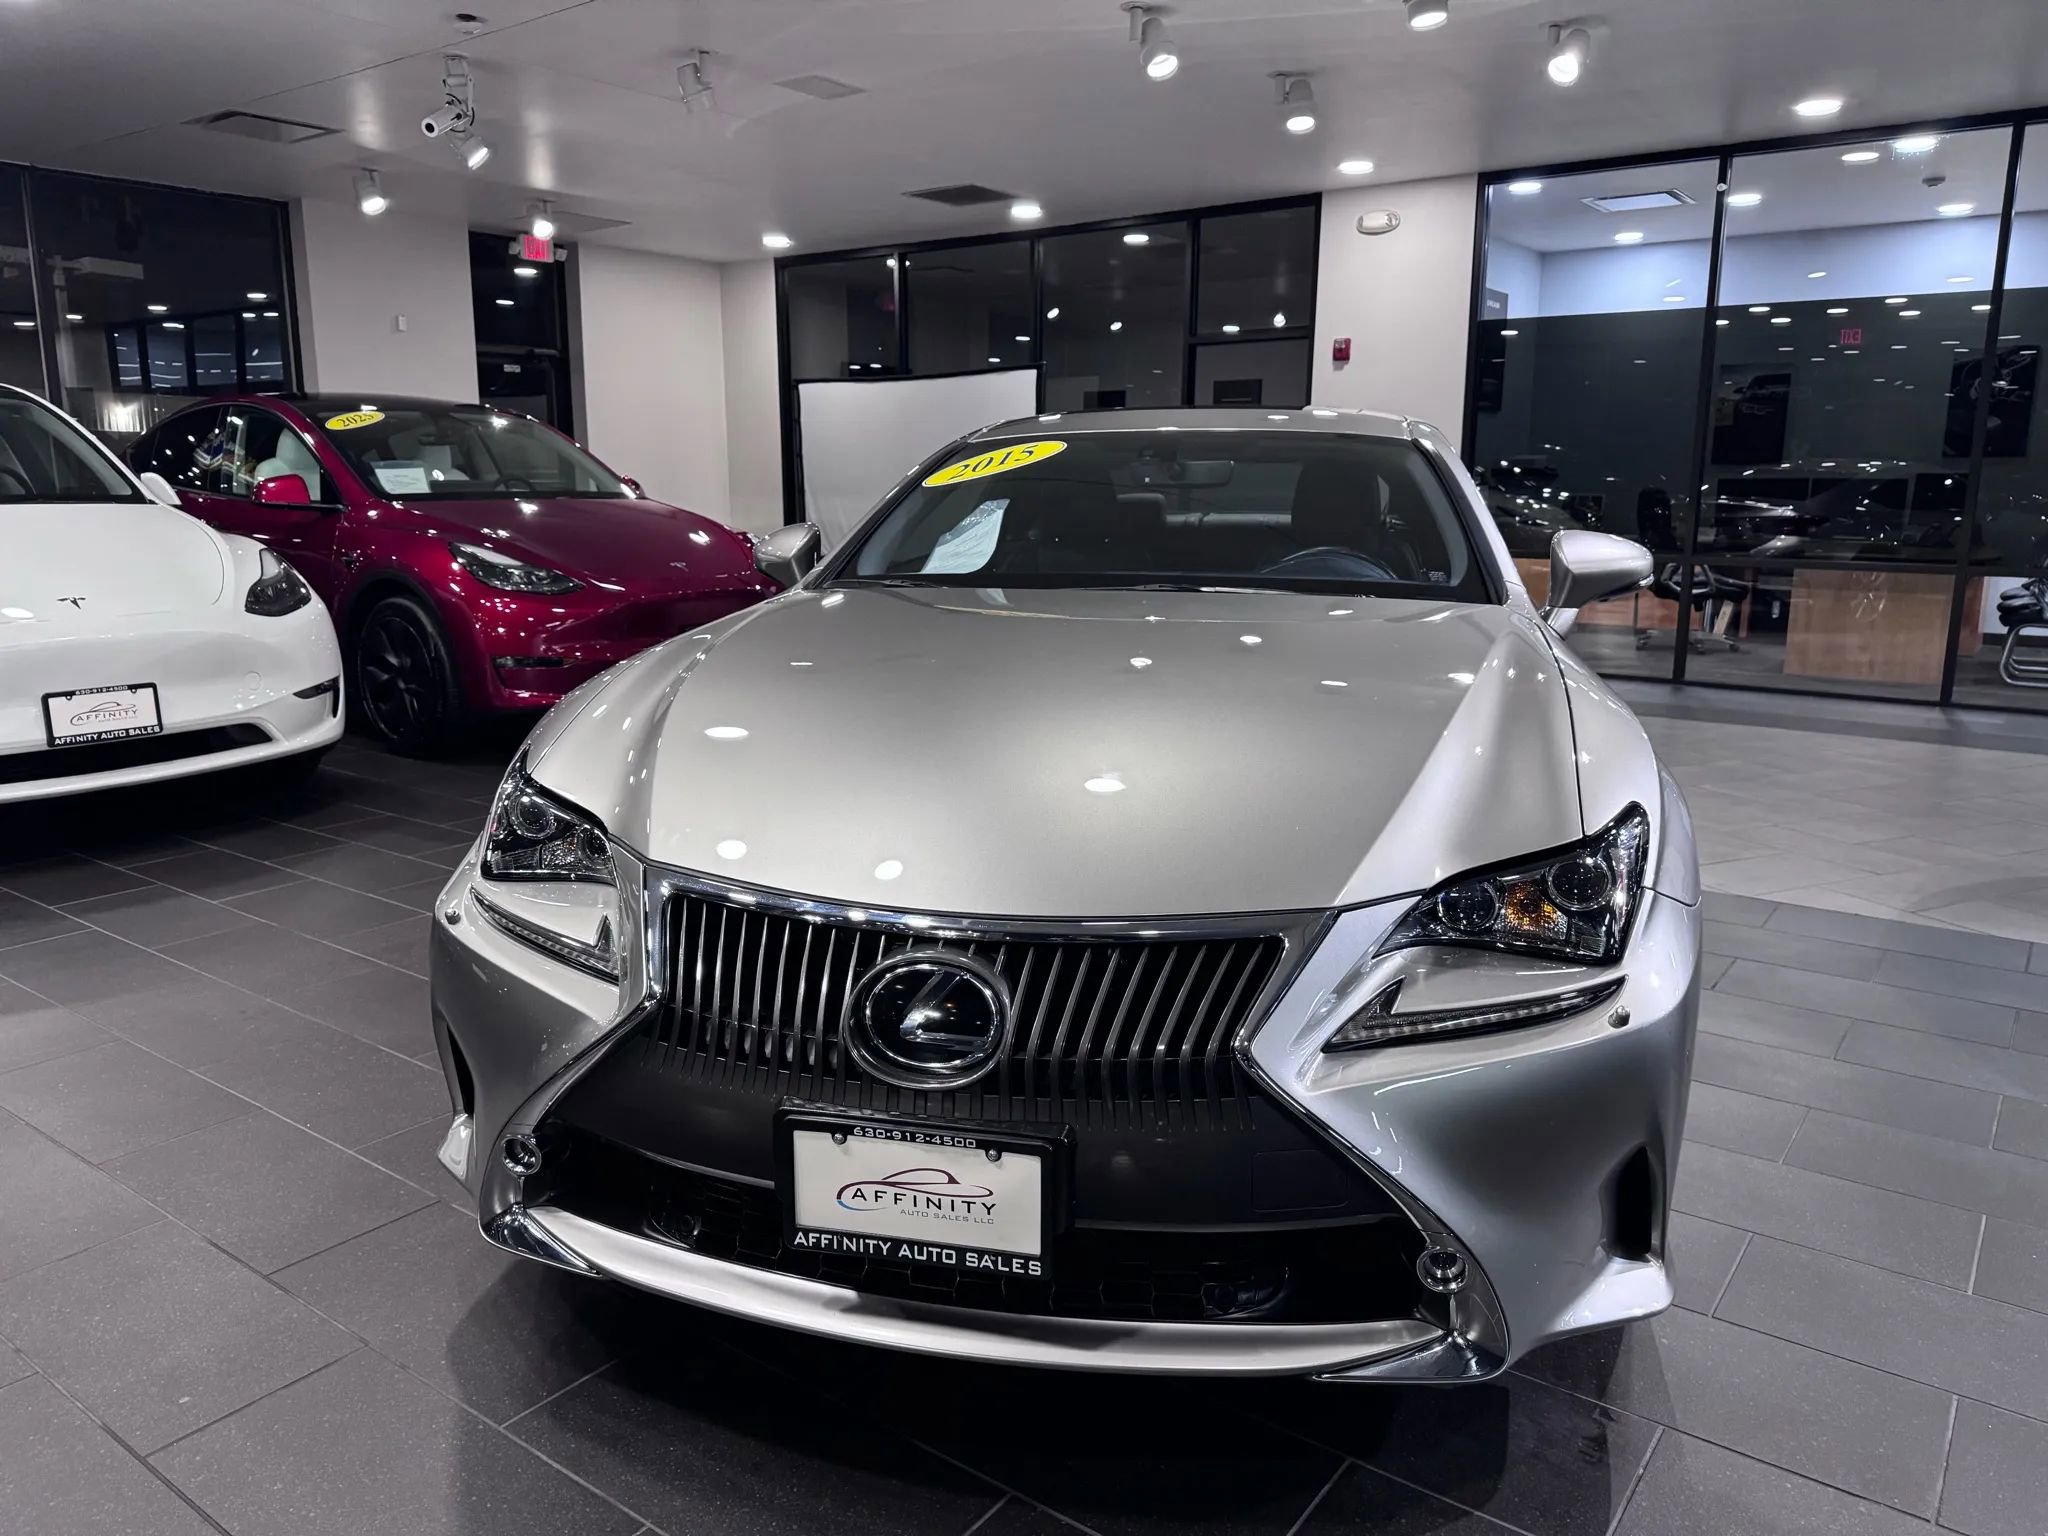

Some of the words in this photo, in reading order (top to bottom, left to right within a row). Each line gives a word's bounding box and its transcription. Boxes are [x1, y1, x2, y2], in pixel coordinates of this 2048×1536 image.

[947, 444, 1039, 482] 2015
[76, 708, 138, 722] AFFINITY
[54, 733, 99, 745] AFFINITY
[100, 730, 126, 739] AUTO
[128, 725, 160, 736] SALES
[853, 1126, 976, 1148] 630-912-4500
[851, 1187, 997, 1216] AFFINITY
[900, 1208, 929, 1218] AUTO
[933, 1212, 969, 1222] SALES
[974, 1216, 994, 1225] LLC
[793, 1231, 892, 1256] AFFINITY
[898, 1243, 956, 1265] AUTO
[965, 1252, 1042, 1276] SALES
